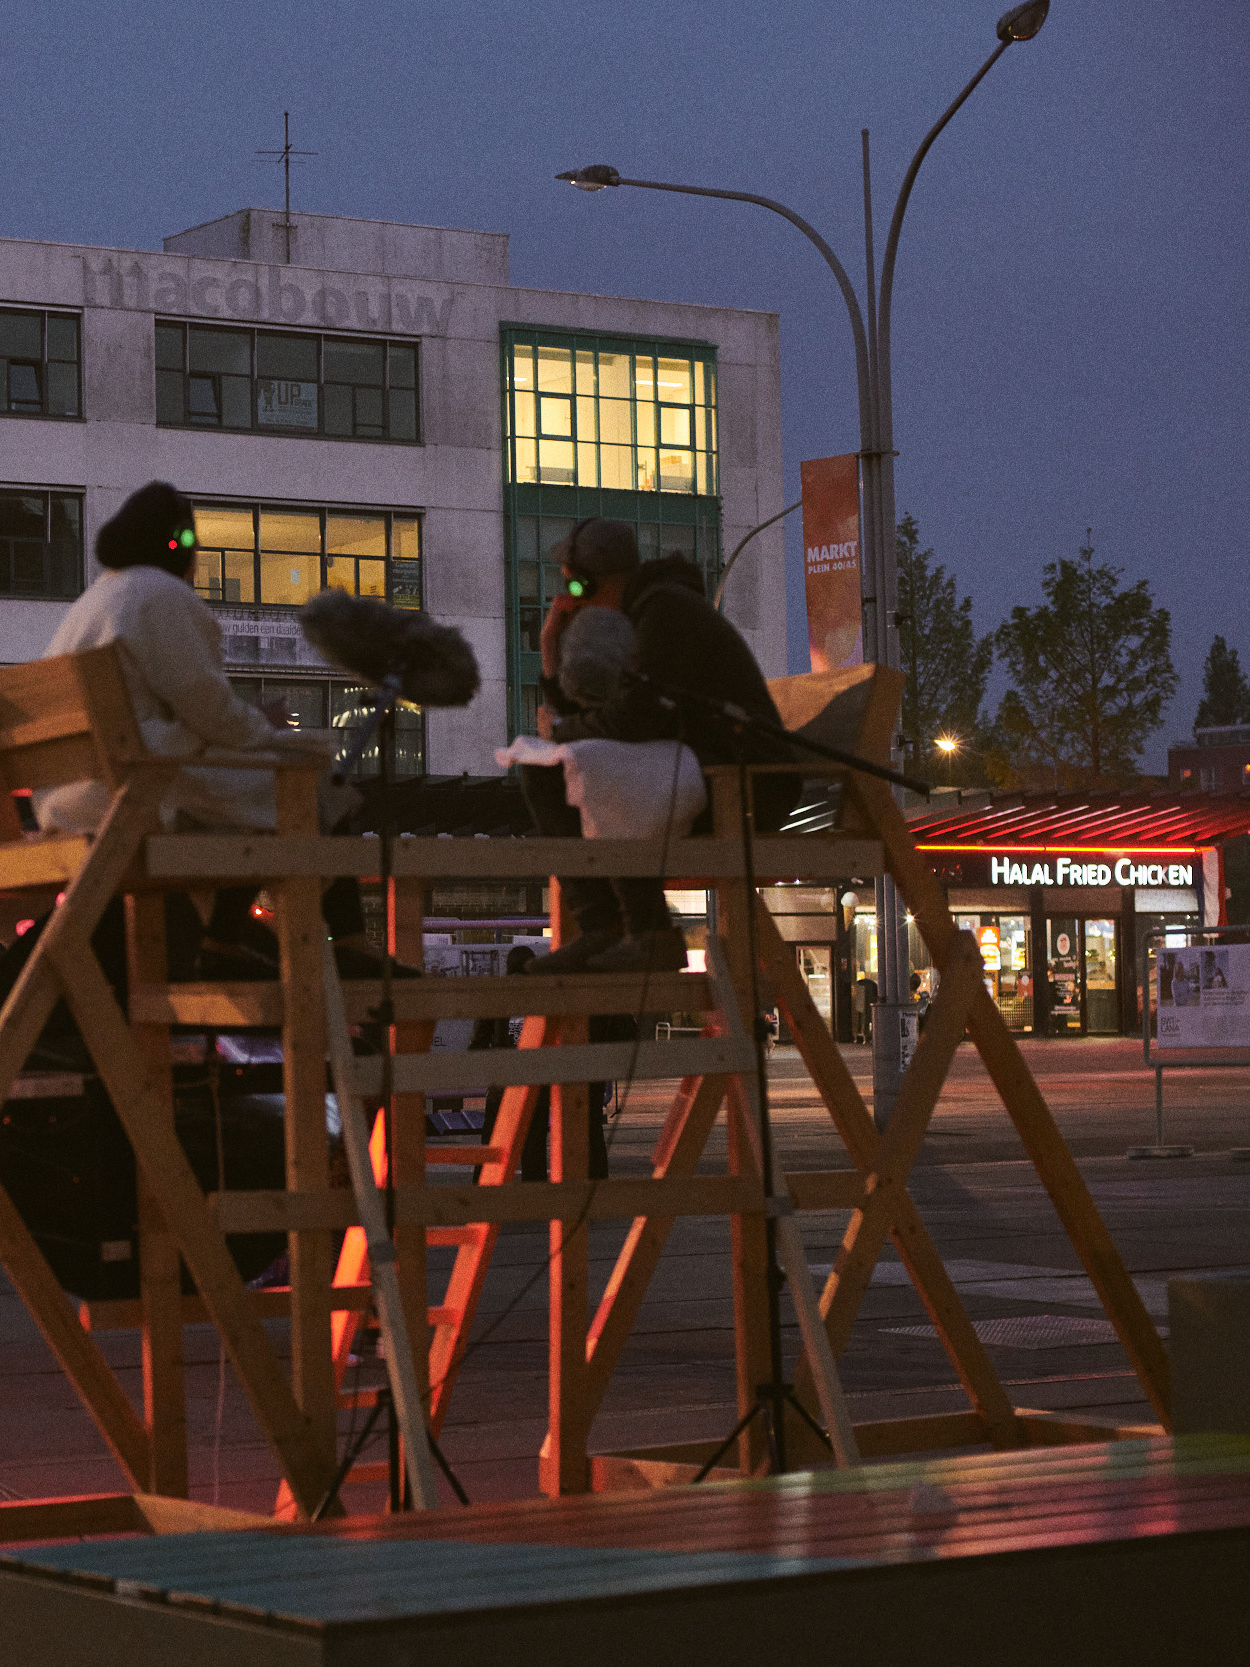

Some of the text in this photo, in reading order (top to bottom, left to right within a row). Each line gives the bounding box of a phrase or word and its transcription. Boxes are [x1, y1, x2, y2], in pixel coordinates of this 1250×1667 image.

[277, 382, 302, 405] UP
[807, 541, 858, 563] MARKT
[808, 563, 830, 575] PLEIN
[232, 623, 259, 635] gulden
[260, 625, 275, 634] een
[990, 856, 1193, 886] HALAL FRIED CHICKEN
